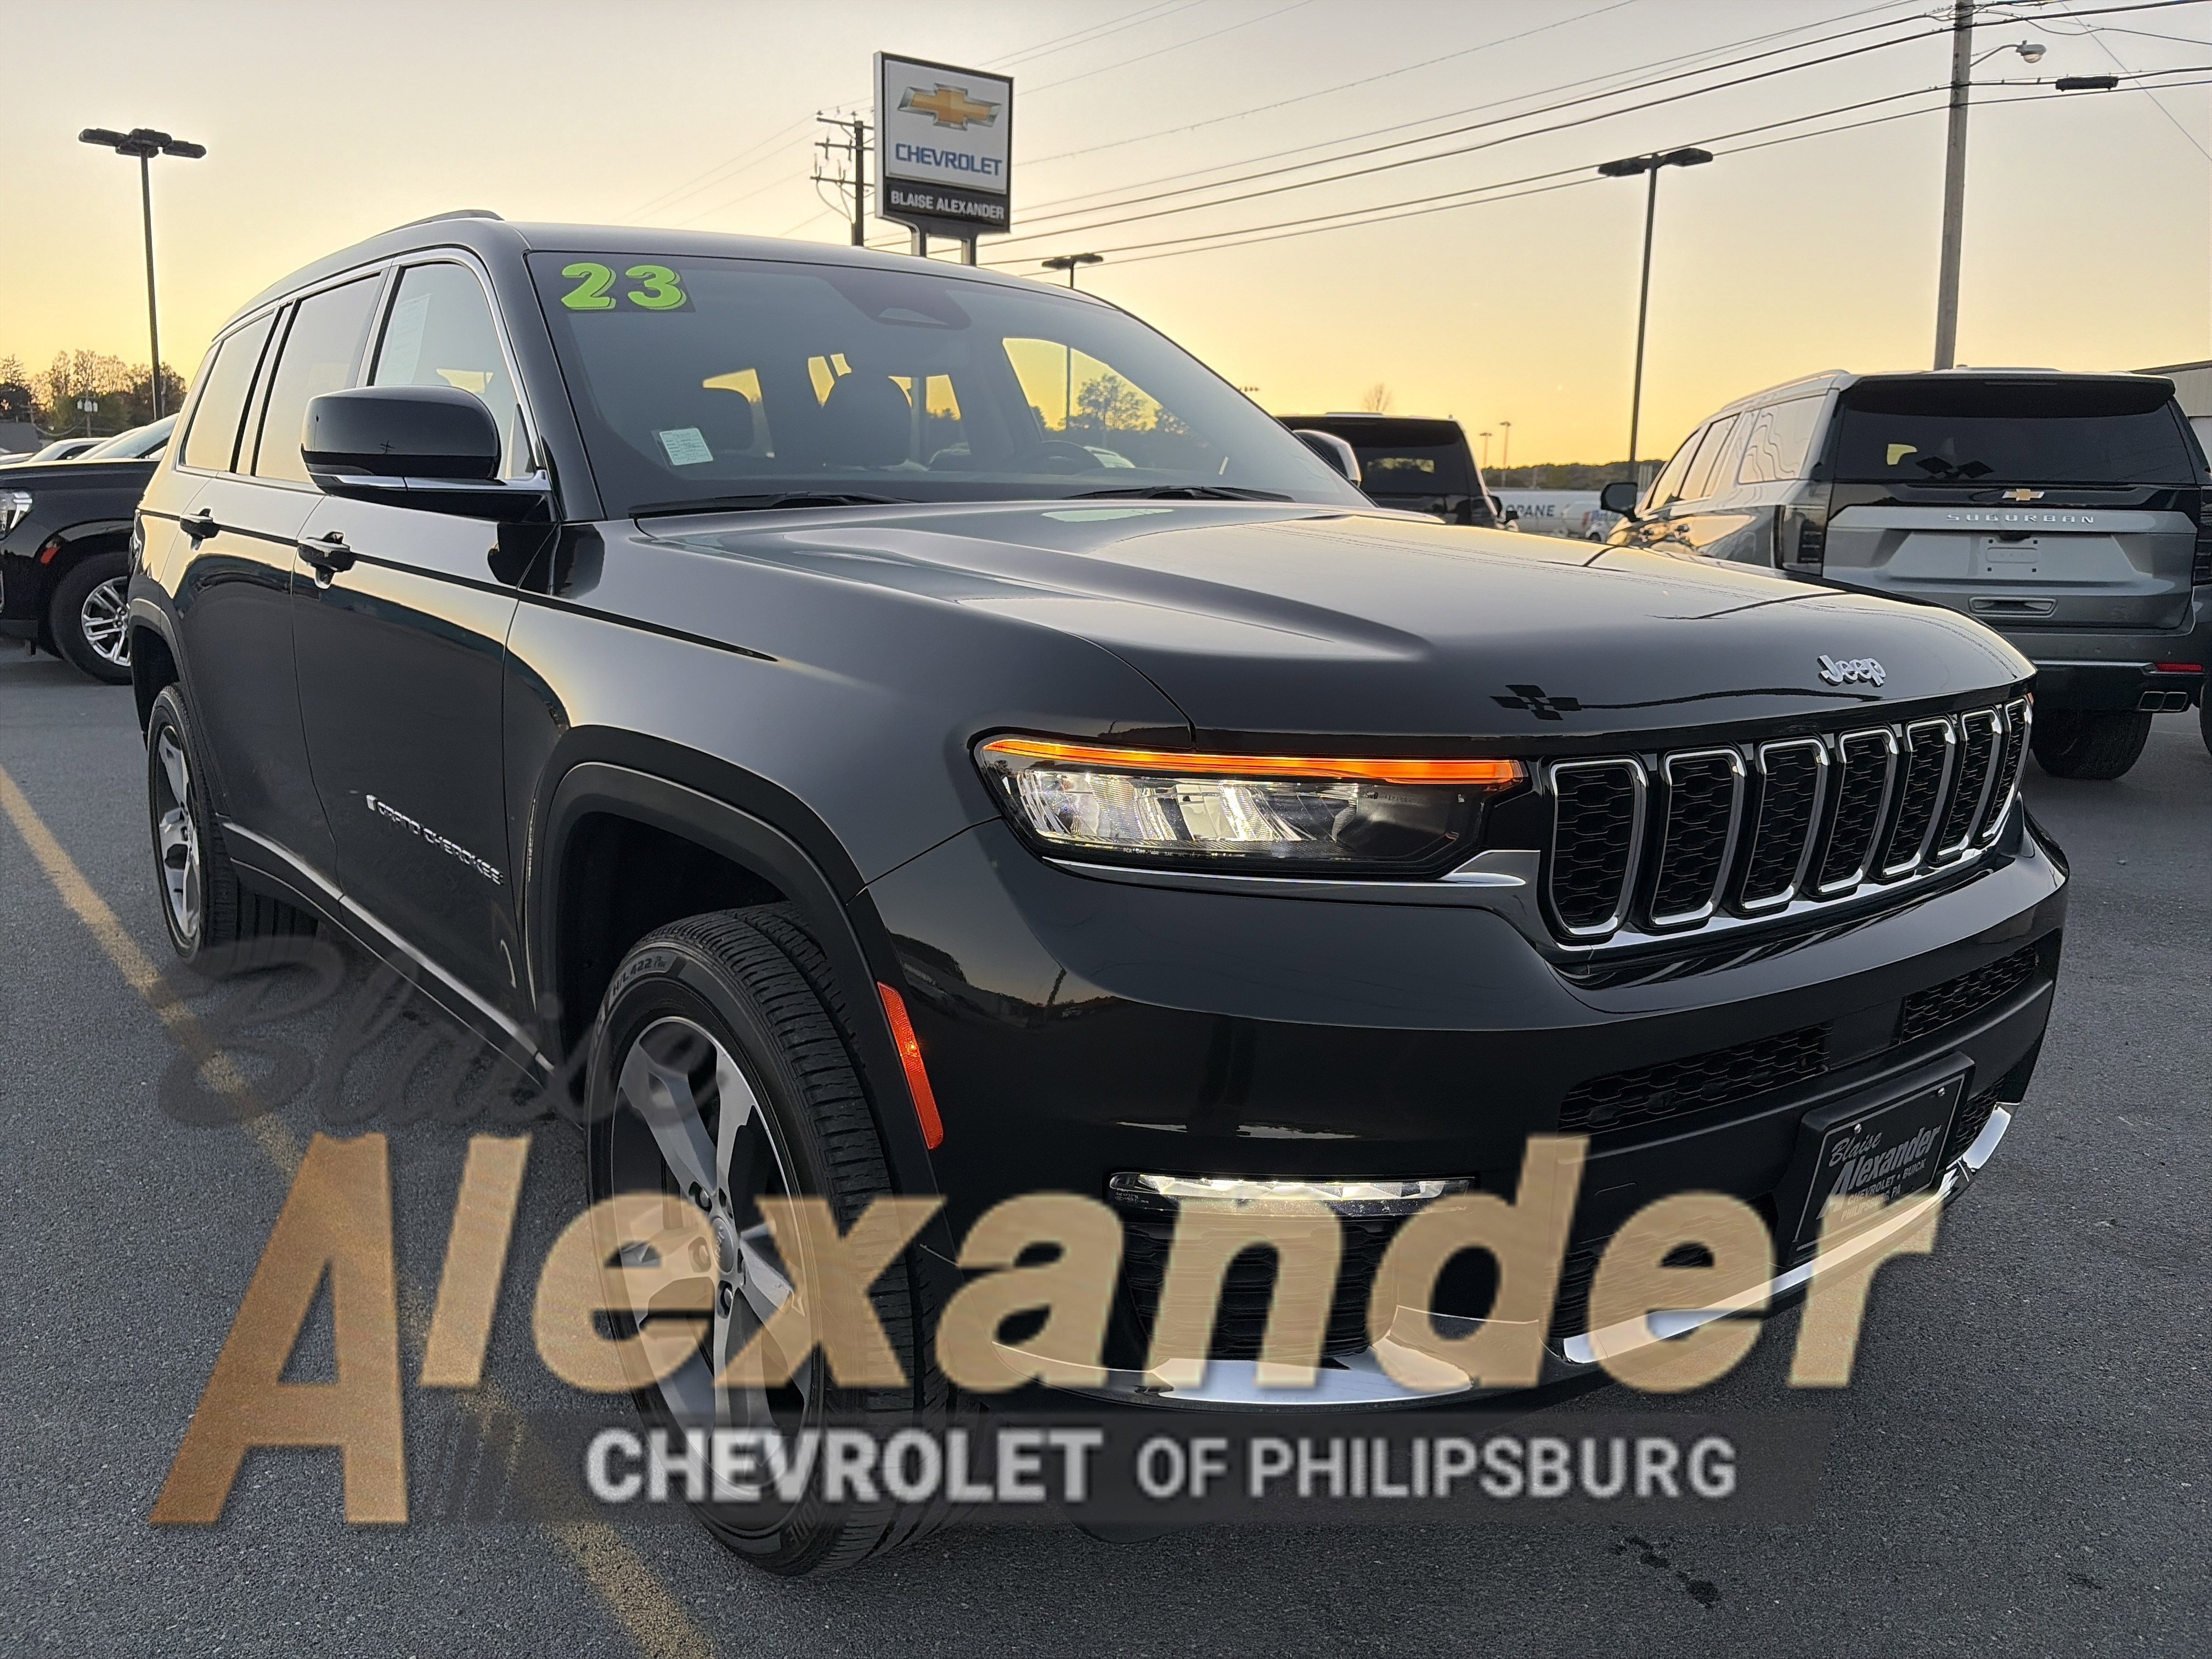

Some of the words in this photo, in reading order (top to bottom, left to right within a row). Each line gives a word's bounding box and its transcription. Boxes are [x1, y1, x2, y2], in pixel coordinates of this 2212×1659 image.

[894, 143, 1003, 176] CHEVROLET
[890, 189, 934, 210] BLAISE
[936, 197, 1005, 220] ALEXANDER
[561, 262, 687, 311] 23
[1947, 514, 2094, 524] SUBURBAN
[1817, 654, 1886, 687] Jeep
[423, 827, 504, 885] CHEROKEE
[630, 958, 652, 975] 422
[1829, 1132, 1882, 1167] Blaise
[1815, 1125, 1942, 1220] Alexander
[1847, 1175, 1895, 1205] CHEVROLET
[1902, 1158, 1927, 1180] BUICK
[1891, 1184, 1901, 1198] PA
